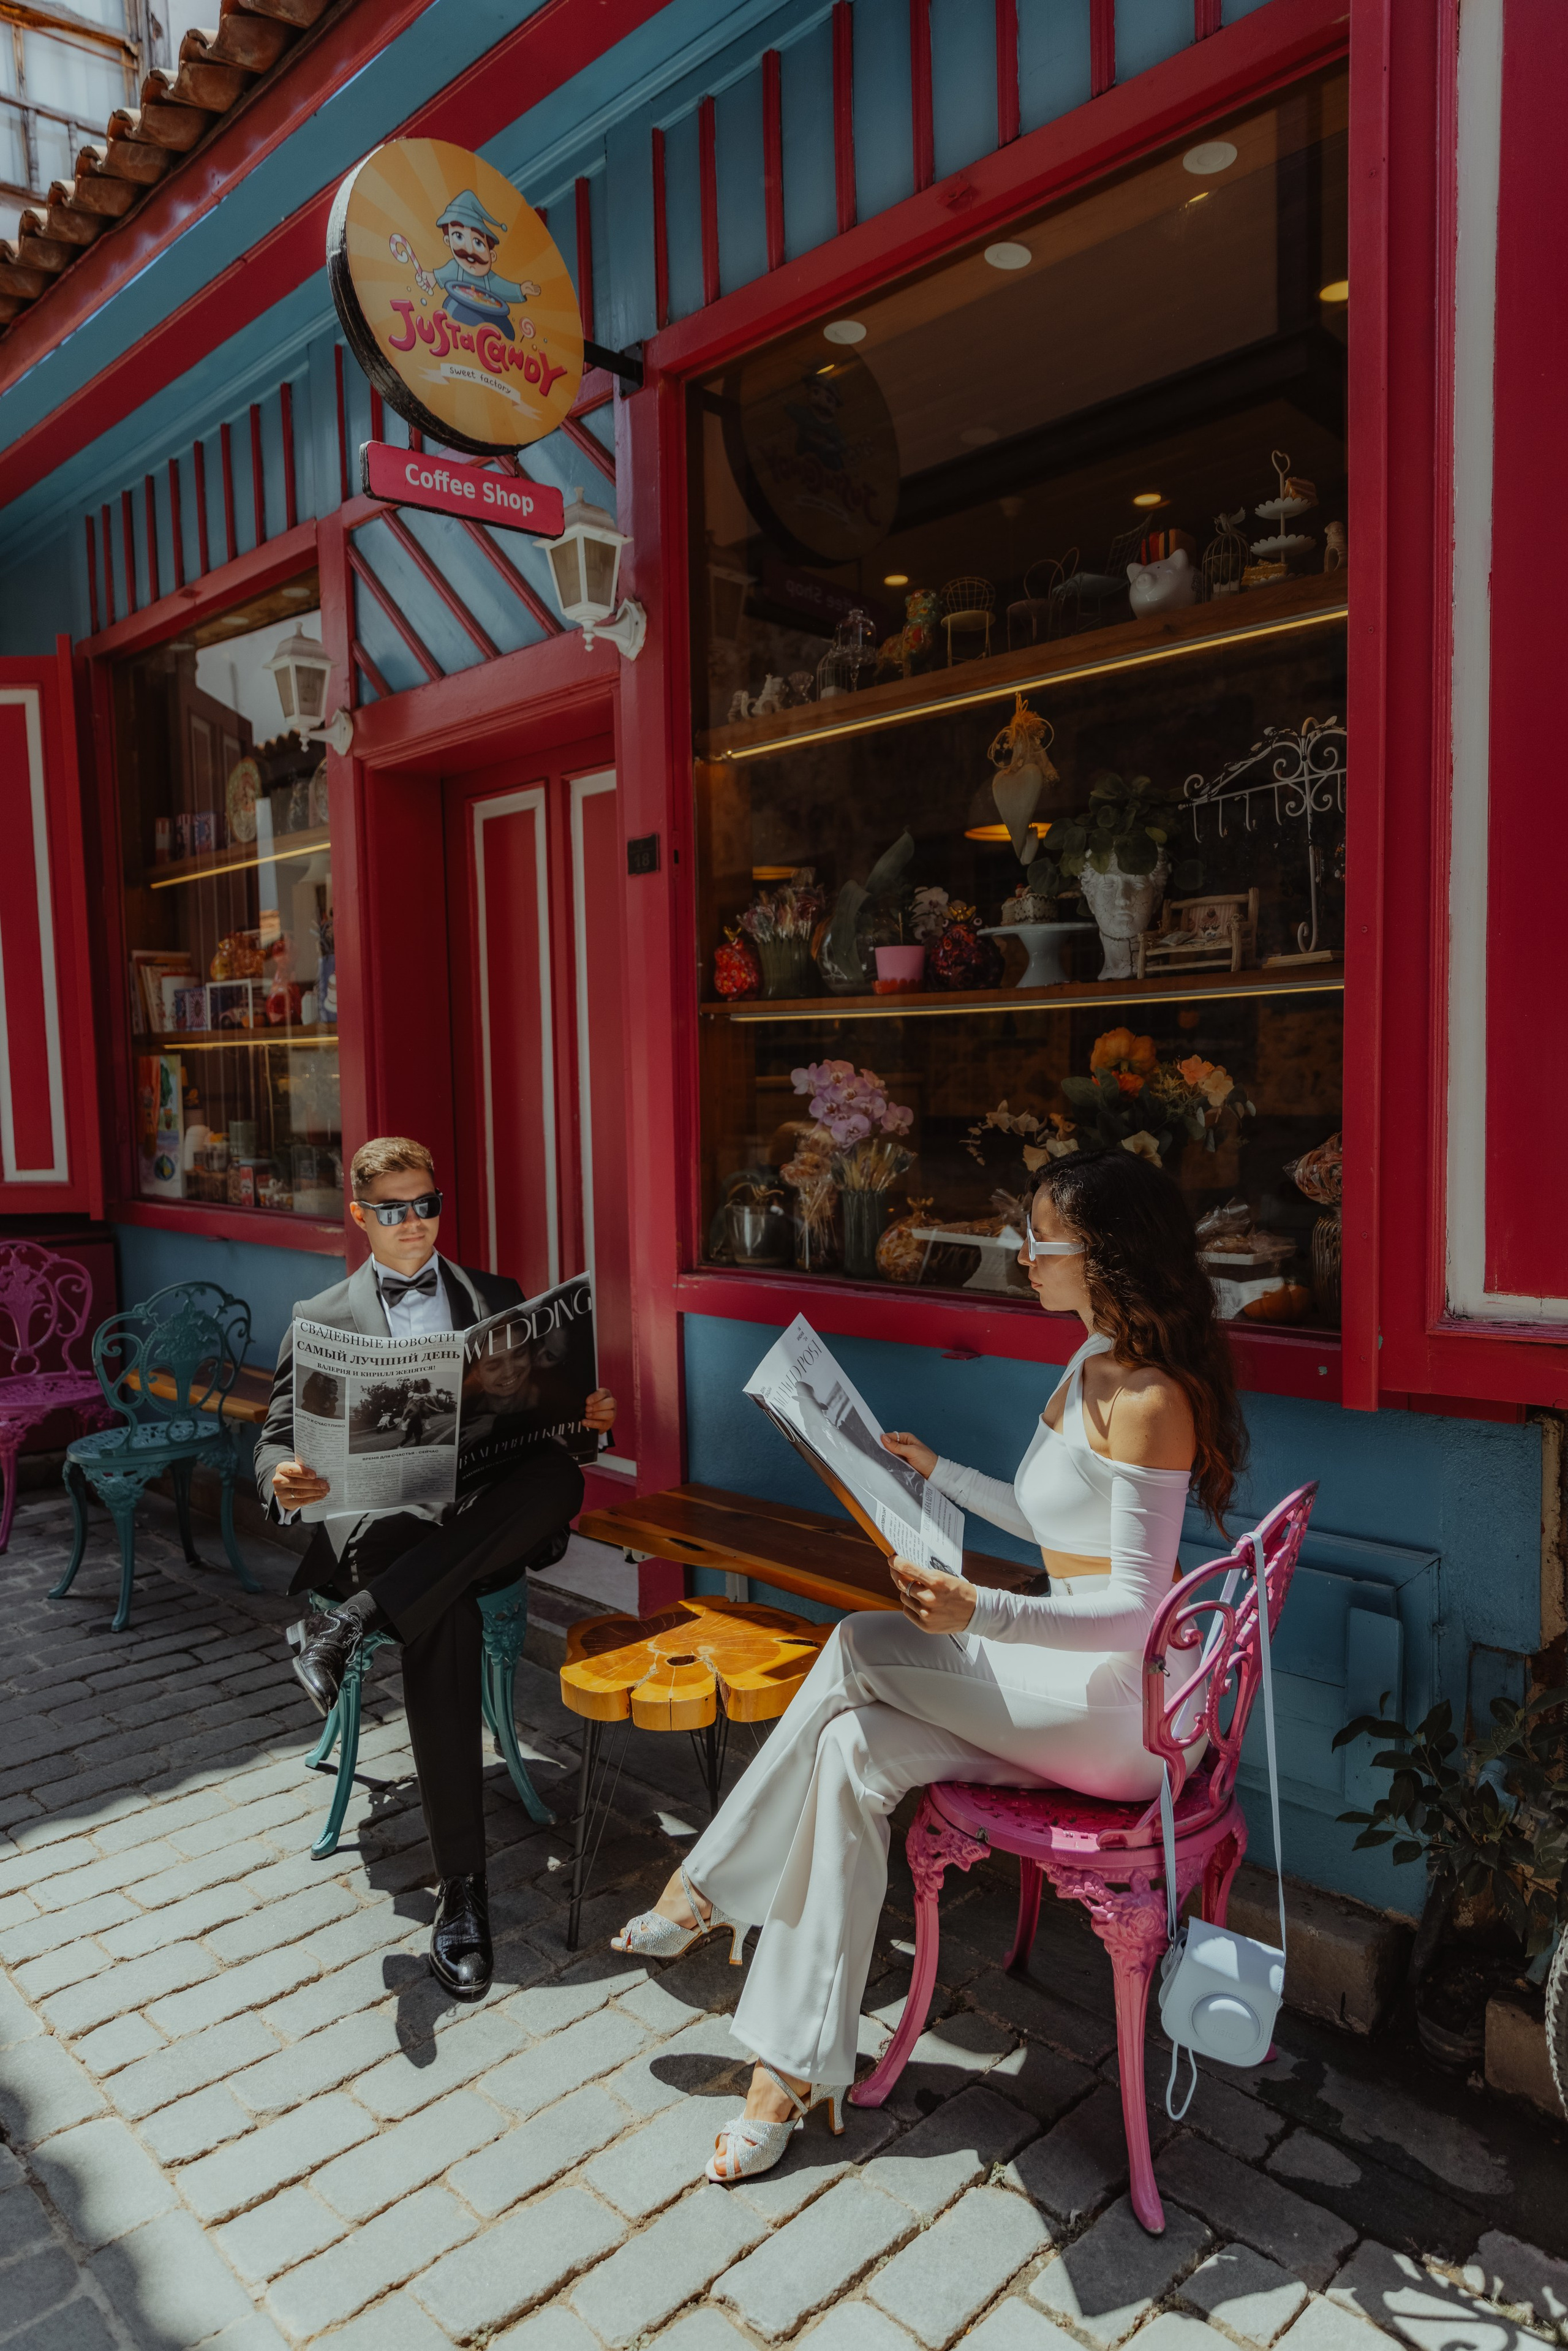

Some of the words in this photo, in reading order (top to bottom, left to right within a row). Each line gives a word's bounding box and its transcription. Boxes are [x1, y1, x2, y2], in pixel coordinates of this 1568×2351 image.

[480, 374, 511, 394] factory
[405, 463, 475, 499] Coffee
[483, 481, 535, 517] Shop
[300, 1322, 383, 1348] СВАДЕБНЫЕ
[387, 1333, 456, 1349] НОВОСТИ
[464, 1286, 592, 1364] WEDDING
[297, 1340, 347, 1363] САМЫЙ
[350, 1352, 418, 1367] ЛУЧШИЙ
[421, 1350, 461, 1363] ДЕНЬ
[797, 1339, 822, 1373] POST
[317, 1362, 351, 1376] ВАЛЕРИЯ
[395, 1365, 435, 1376] ЖЕНЯТСЯ!
[295, 1413, 311, 1422] ДОЛГО
[314, 1420, 345, 1428] СЧАСТЛИВО
